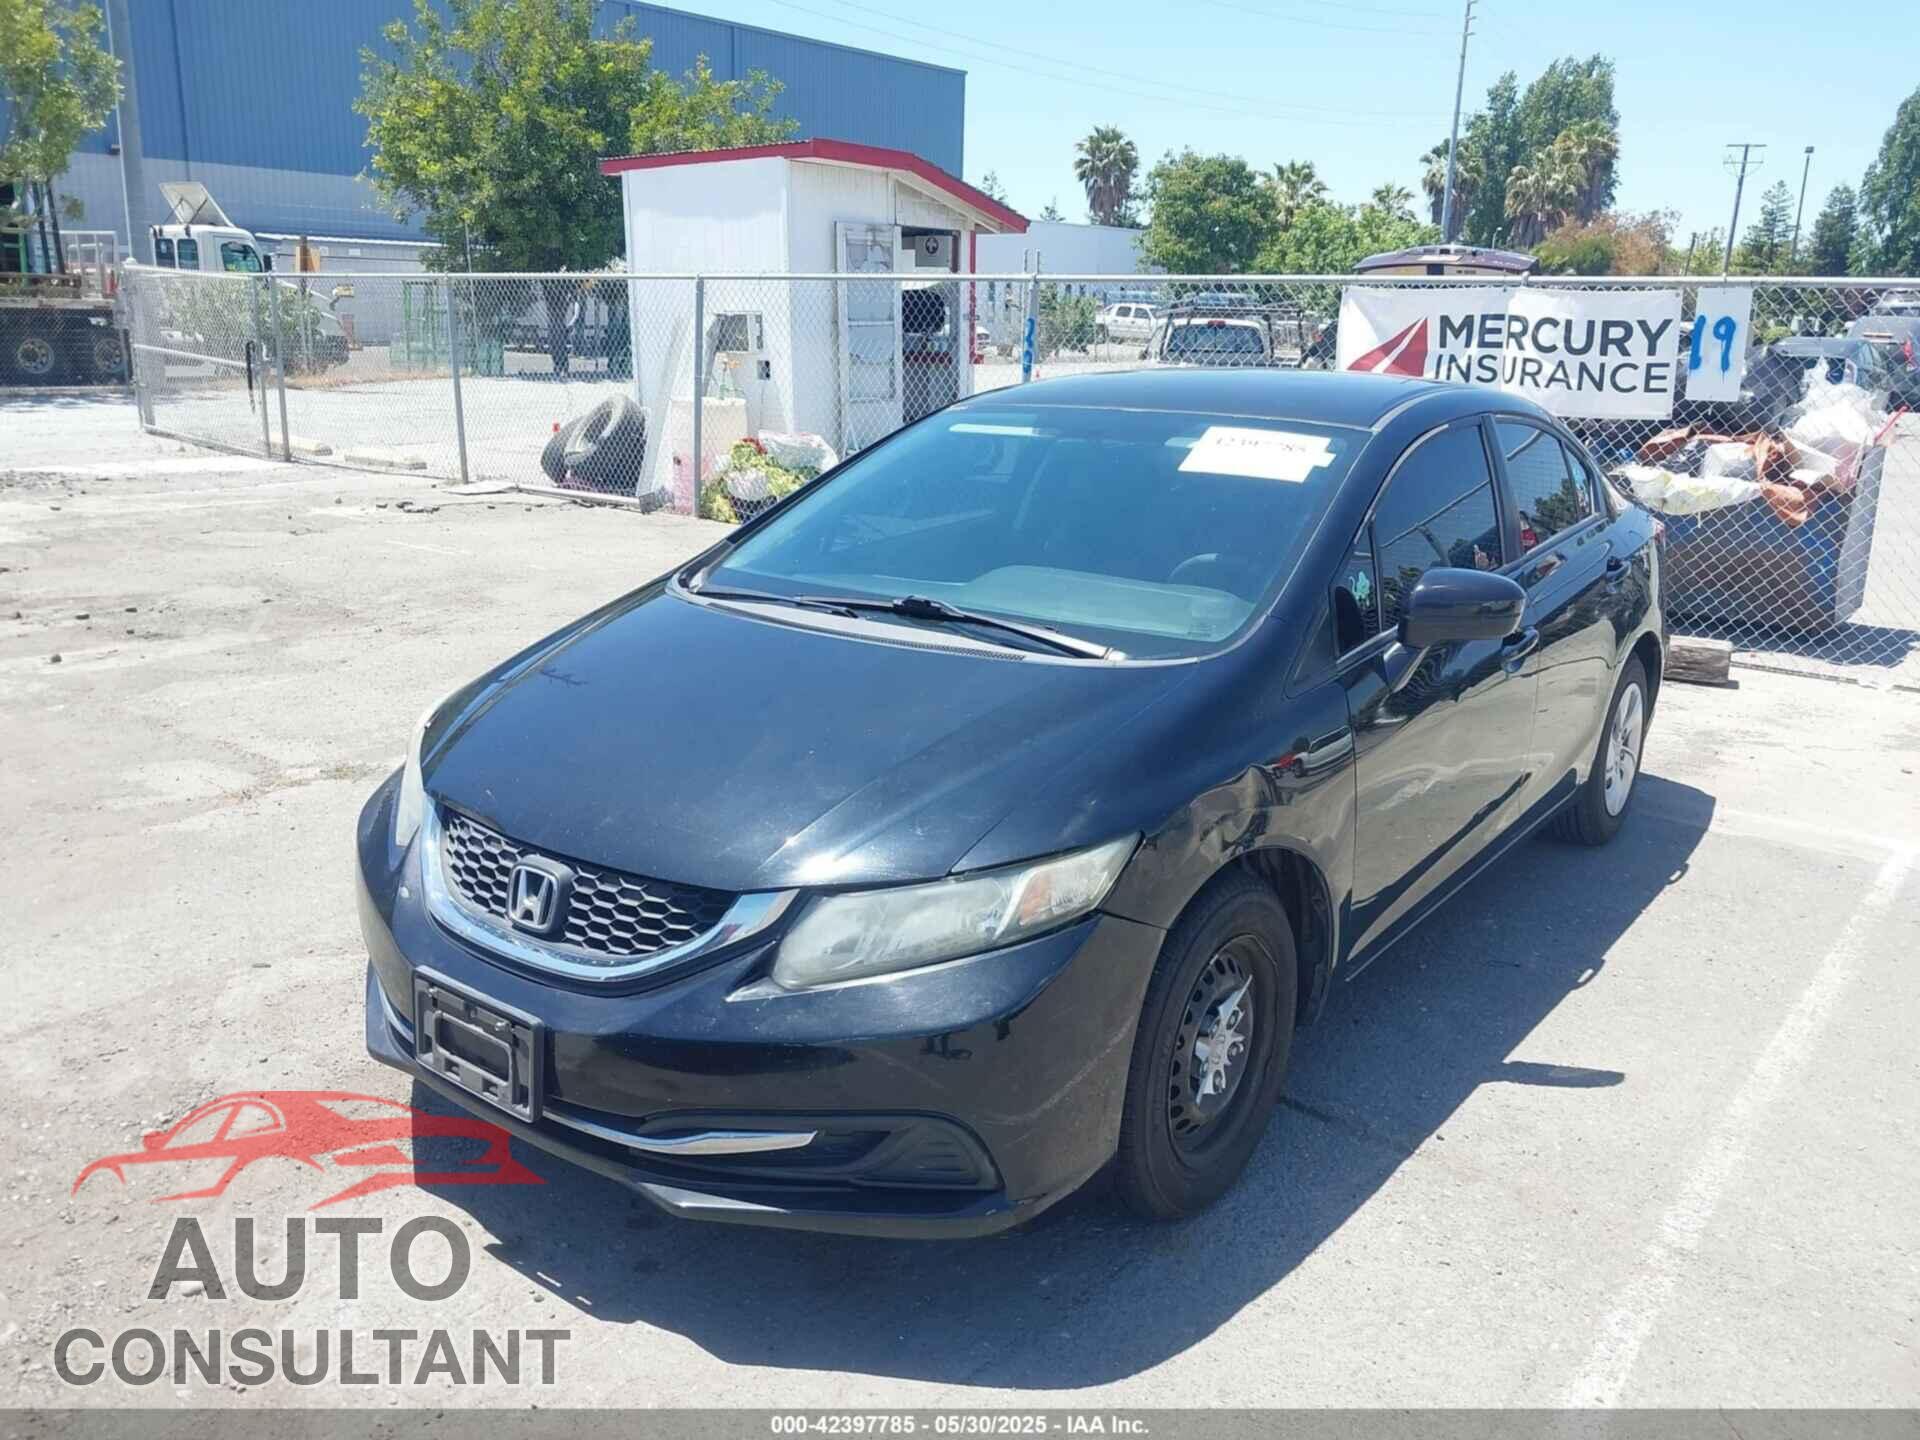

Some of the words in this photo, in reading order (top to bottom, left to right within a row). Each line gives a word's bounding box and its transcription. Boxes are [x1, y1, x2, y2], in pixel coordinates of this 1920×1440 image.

[1438, 314, 1674, 357] MERCURY
[1688, 313, 1738, 374] 19
[1434, 353, 1671, 394] INSURANCE
